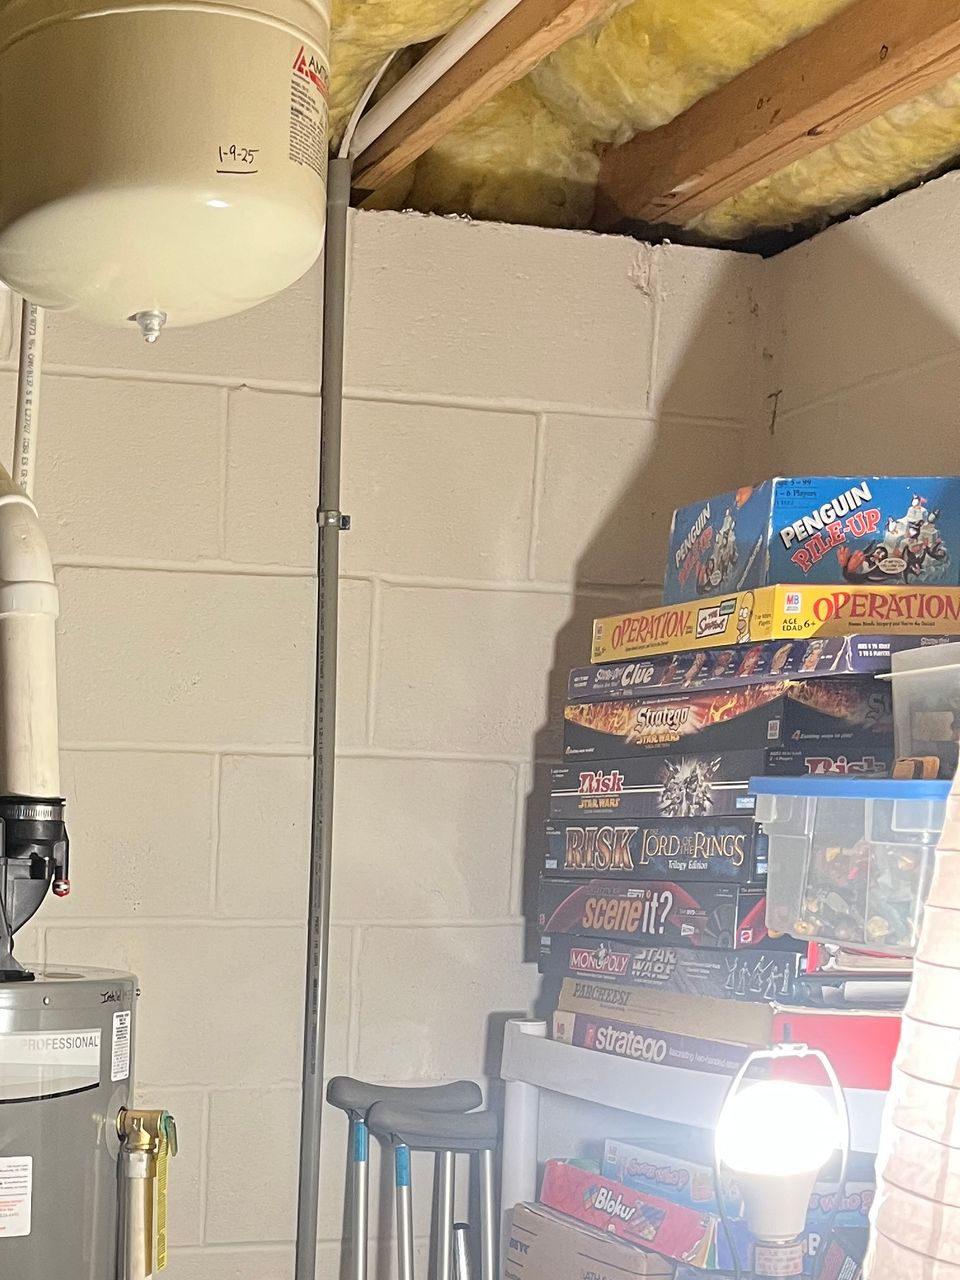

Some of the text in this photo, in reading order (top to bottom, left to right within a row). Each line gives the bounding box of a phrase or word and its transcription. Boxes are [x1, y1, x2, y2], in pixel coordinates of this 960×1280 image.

[218, 144, 260, 164] 1-9-25
[780, 481, 873, 548] PENGUIN
[675, 502, 711, 568] PENGUIN
[791, 508, 880, 573] PILE-UP
[786, 594, 799, 605] MB
[813, 592, 960, 623] OPERATION
[611, 611, 692, 650] OPERATION
[803, 619, 816, 628] 6+
[621, 664, 654, 686] Clue
[633, 707, 690, 732] Stratego
[636, 732, 681, 744] STAR WARS
[578, 770, 624, 794] Risk
[578, 797, 621, 808] STAR WARS
[564, 827, 639, 870] RISK
[640, 829, 680, 865] LORD
[693, 832, 747, 866] RINGS
[668, 860, 687, 871] Trilogy
[627, 889, 645, 898] ESPN
[582, 890, 673, 934] scene it?
[571, 951, 629, 972] MONOPOLY
[634, 947, 677, 964] STAR
[22, 1036, 98, 1051] PROFESSIONAL
[596, 1026, 667, 1062] stratego
